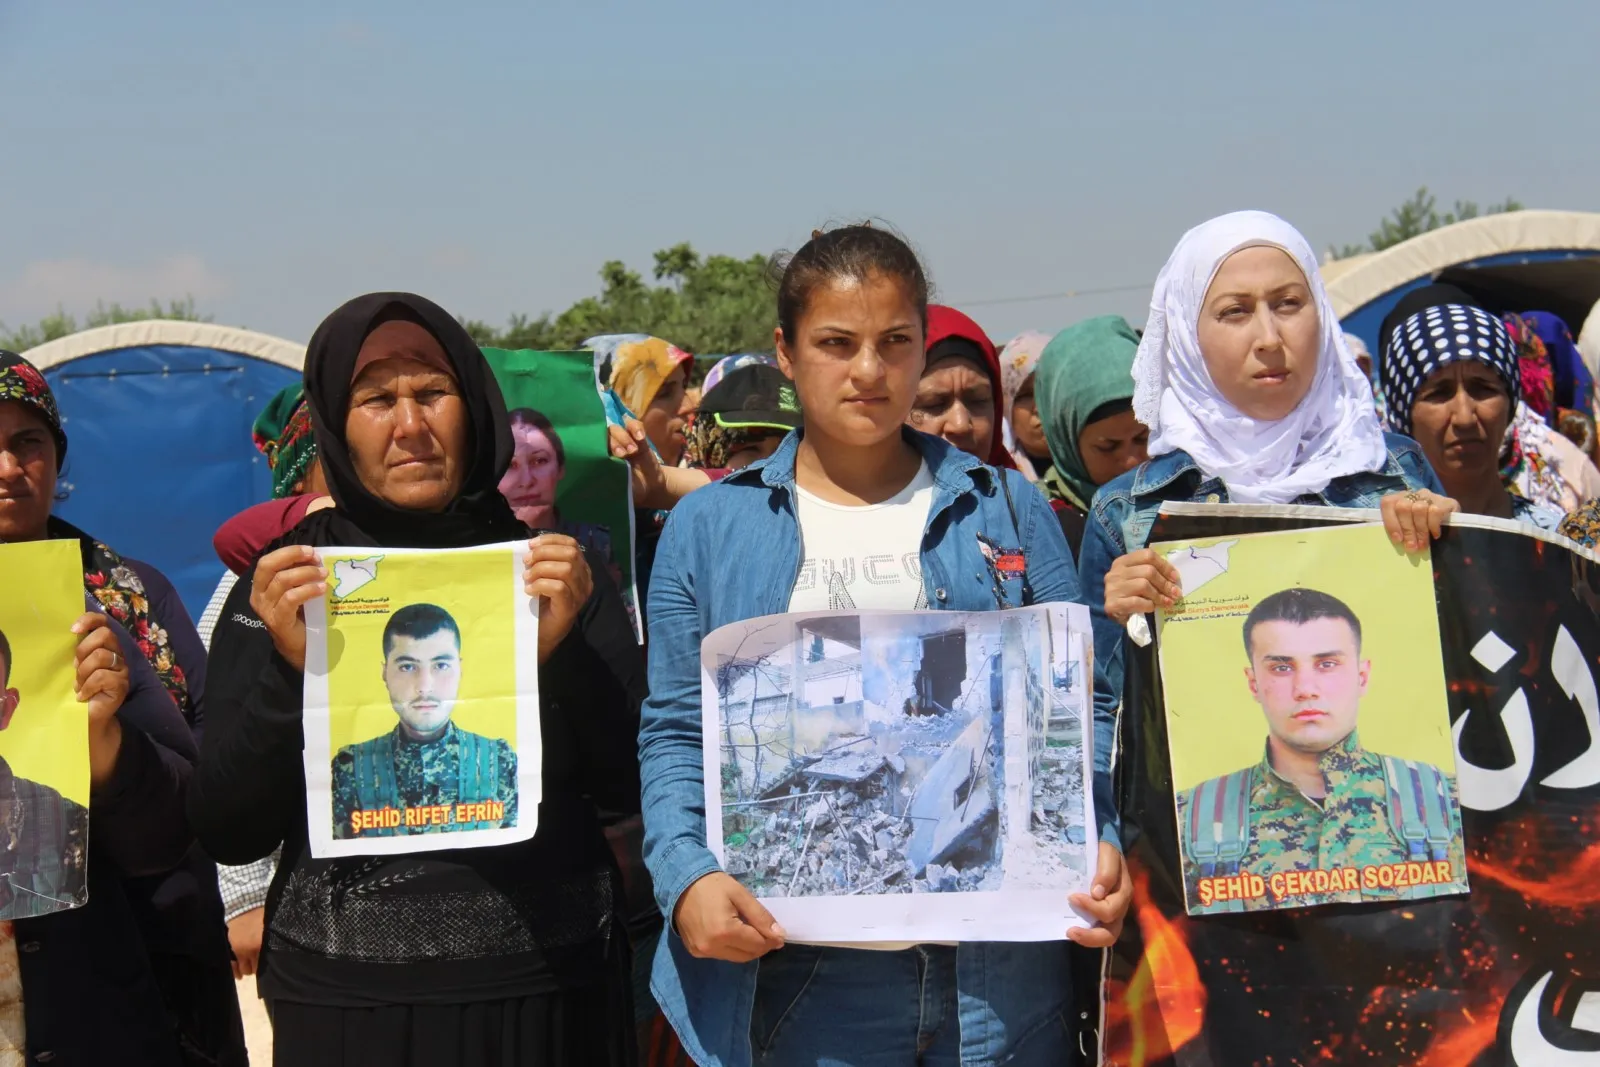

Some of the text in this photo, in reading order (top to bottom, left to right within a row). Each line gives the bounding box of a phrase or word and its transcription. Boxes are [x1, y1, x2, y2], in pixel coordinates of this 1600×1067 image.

[351, 798, 505, 834] ŞEHÎD RIFET EFRÎN
[1198, 860, 1452, 905] ŞEHÎD ÇEKDAR SOZDAR
